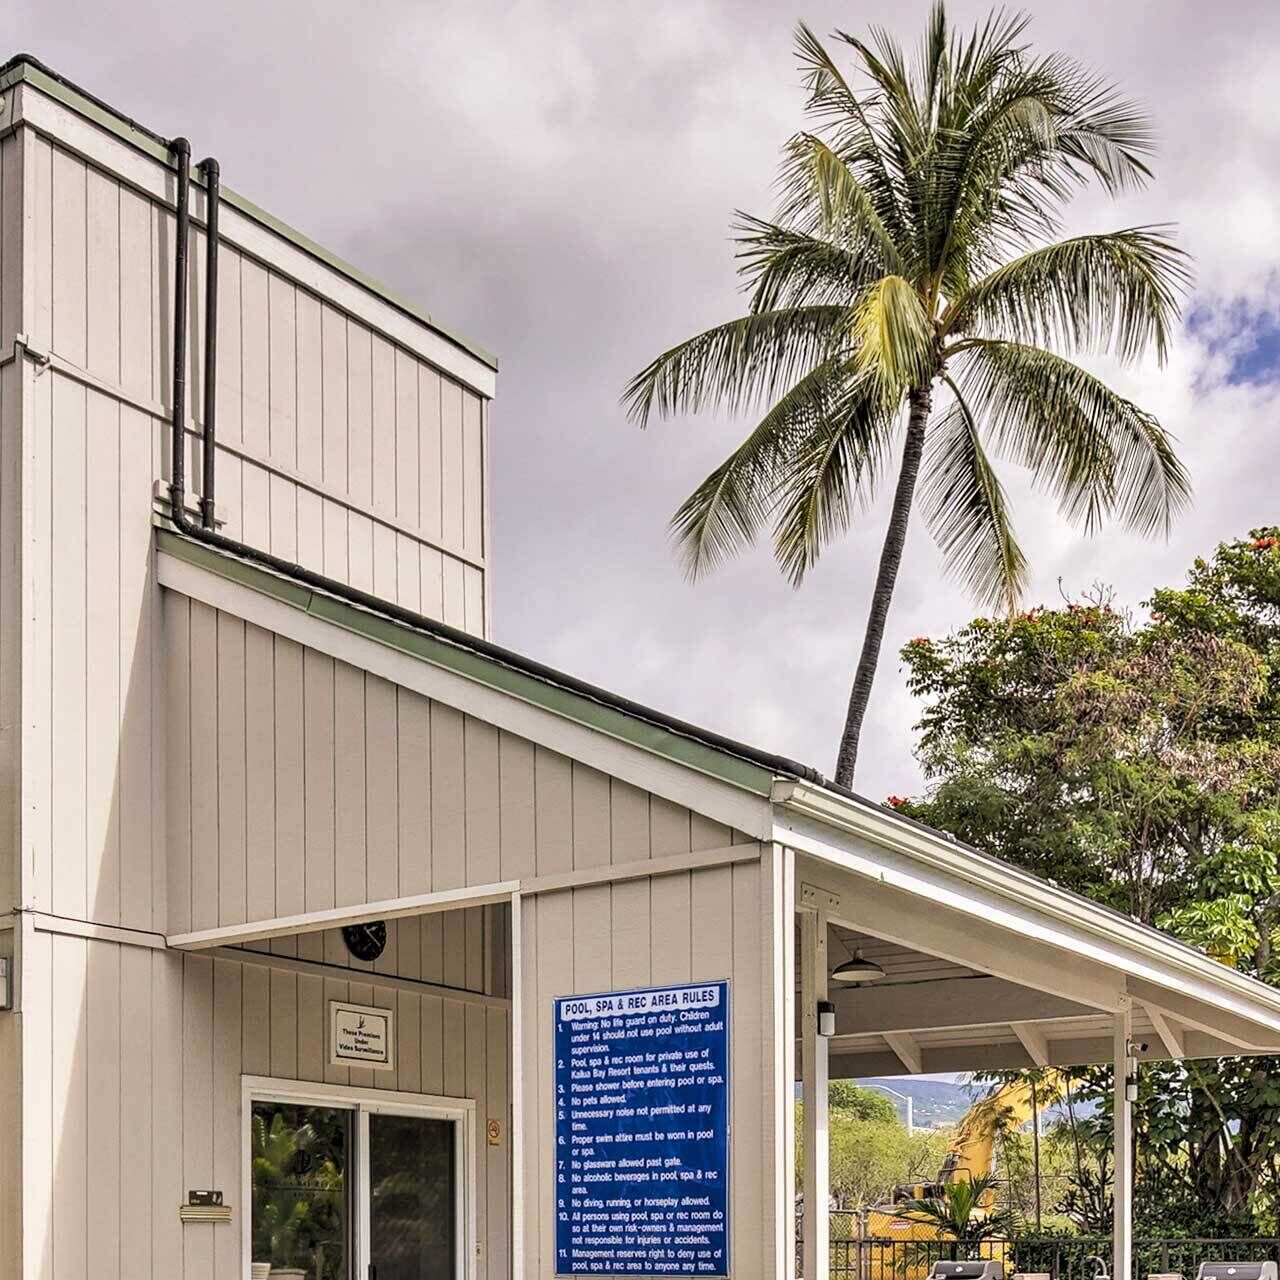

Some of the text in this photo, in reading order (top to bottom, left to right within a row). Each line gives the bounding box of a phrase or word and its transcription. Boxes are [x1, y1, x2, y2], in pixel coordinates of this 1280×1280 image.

[565, 989, 714, 1017] POOL, SPA & REC AREA RULES
[600, 1018, 611, 1028] No
[613, 1017, 623, 1027] life
[625, 1015, 645, 1027] guard
[647, 1016, 657, 1024] on
[659, 1012, 676, 1024] duty.
[679, 1008, 709, 1021] Children
[571, 1021, 723, 1042] under 14 should not use pool without adult
[589, 1058, 601, 1067] spa
[603, 1055, 609, 1064] &
[611, 1056, 622, 1064] rec
[624, 1054, 643, 1063] room
[645, 1052, 655, 1061] for
[658, 1050, 682, 1062] private
[684, 1050, 698, 1059] use
[700, 1048, 708, 1057] of
[592, 1067, 605, 1079] Bay
[607, 1065, 630, 1076] Resort
[633, 1064, 659, 1074] tenants
[661, 1063, 666, 1072] &
[670, 1062, 686, 1072] their
[558, 1075, 722, 1093] 3. Please shower before entering pool or spa.
[558, 1098, 565, 1106] 4.
[571, 1096, 581, 1105] No
[582, 1095, 597, 1106] pets
[558, 1103, 711, 1120] 5. Unnecessary noise not permitted at any
[558, 1129, 713, 1145] 6. Proper swim attire must be worn in pool
[581, 1147, 594, 1156] spa.
[558, 1160, 565, 1169] 7.
[571, 1160, 581, 1169] No
[583, 1158, 616, 1170] glassware
[618, 1157, 644, 1167] allowed
[646, 1157, 661, 1168] past
[558, 1173, 565, 1183] 8.
[571, 1173, 581, 1182] No
[583, 1172, 612, 1182] alcoholic
[614, 1171, 649, 1183] beverages
[679, 1171, 694, 1181] spa
[696, 1169, 702, 1179] &
[705, 1171, 717, 1179] rec
[571, 1198, 581, 1207] No
[644, 1196, 678, 1208] horseplay
[558, 1211, 568, 1220] 10.
[572, 1212, 580, 1220] All
[582, 1212, 609, 1221] persons
[611, 1211, 629, 1222] using
[650, 1212, 663, 1221] spa
[676, 1211, 688, 1219] rec
[690, 1211, 710, 1219] room
[712, 1209, 723, 1219] do
[582, 1223, 589, 1232] at
[591, 1223, 606, 1232] their
[625, 1222, 666, 1232] risk-owners
[668, 1222, 674, 1231] &
[676, 1222, 723, 1233] management
[572, 1236, 582, 1244] not
[584, 1235, 622, 1245] responsible
[625, 1235, 634, 1244] for
[637, 1235, 661, 1245] injuries
[663, 1236, 671, 1244] or
[572, 1248, 614, 1259] Management
[648, 1248, 664, 1259] right
[667, 1249, 674, 1257] to
[677, 1249, 694, 1259] deny
[713, 1249, 721, 1257] of
[590, 1262, 602, 1271] spa
[605, 1260, 610, 1269] &
[644, 1261, 652, 1269] to
[654, 1262, 679, 1271] anyone
[682, 1263, 695, 1271] any
